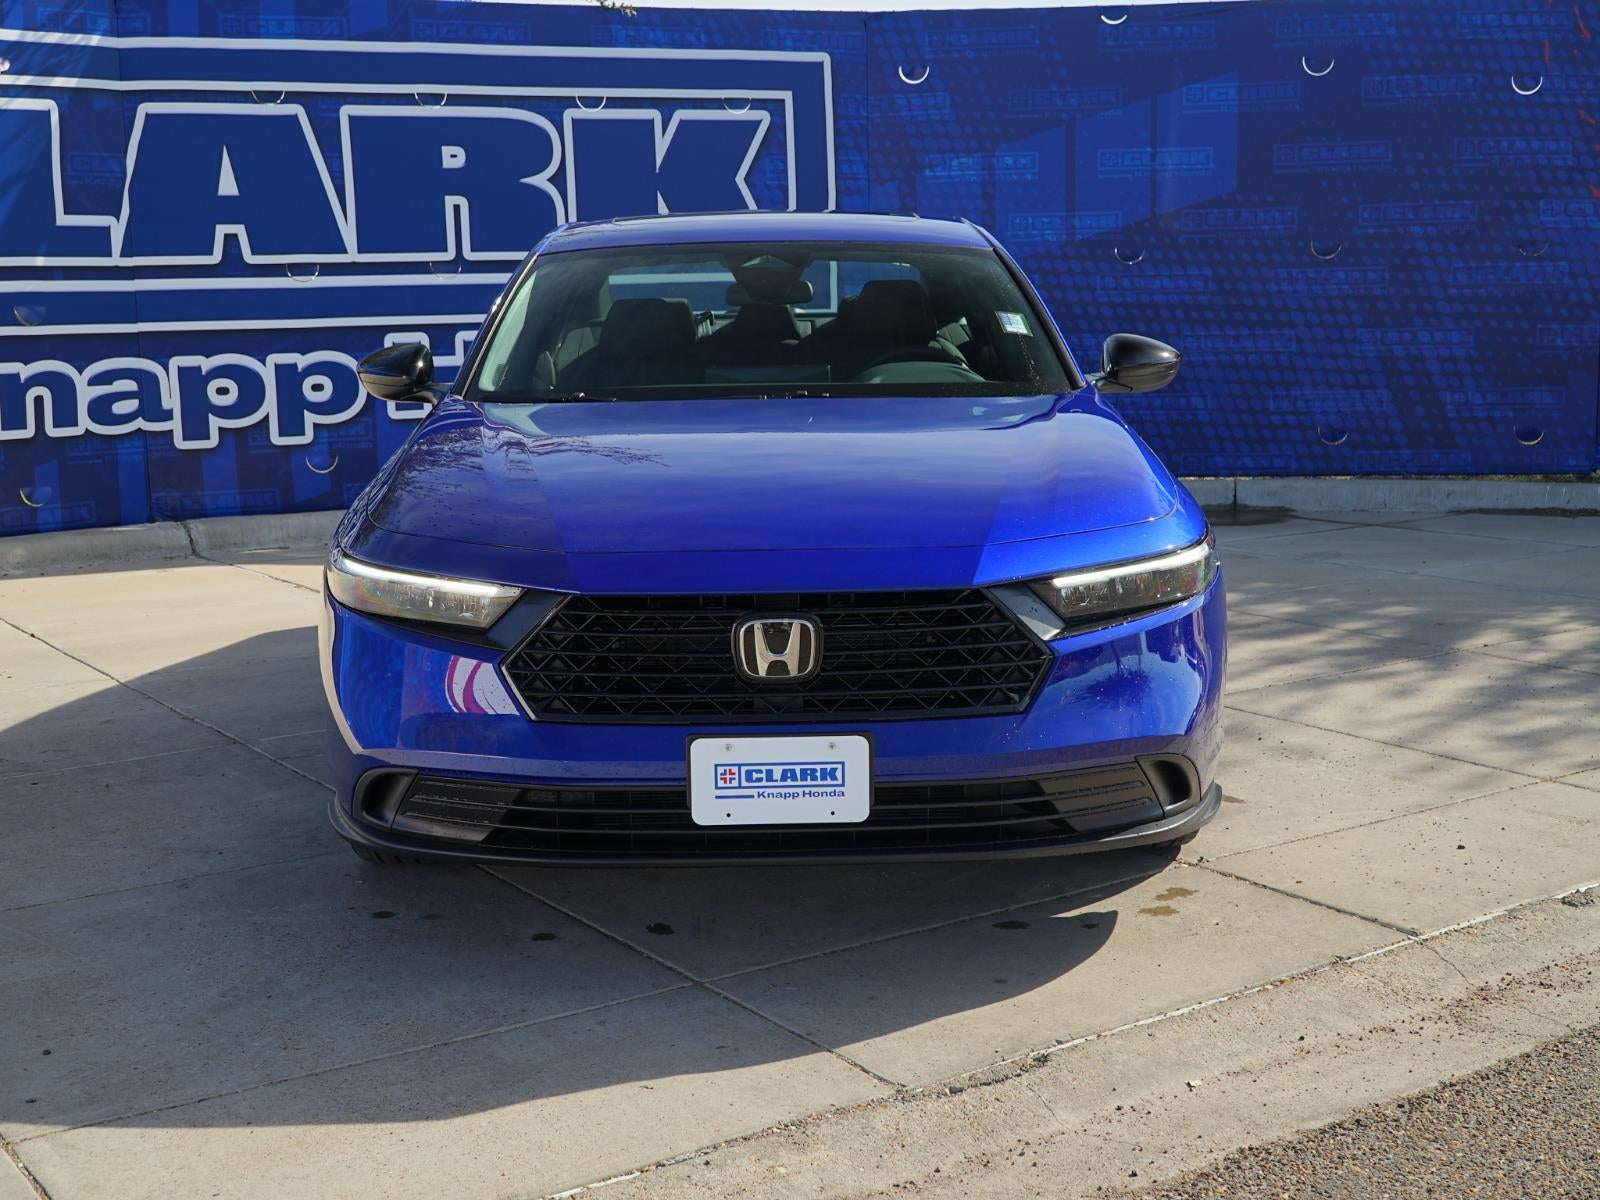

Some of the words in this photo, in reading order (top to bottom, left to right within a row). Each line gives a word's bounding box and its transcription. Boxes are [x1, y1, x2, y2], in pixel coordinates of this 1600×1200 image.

[744, 767, 838, 783] CLARK
[757, 790, 800, 800] Knapp
[802, 788, 845, 799] Honda
